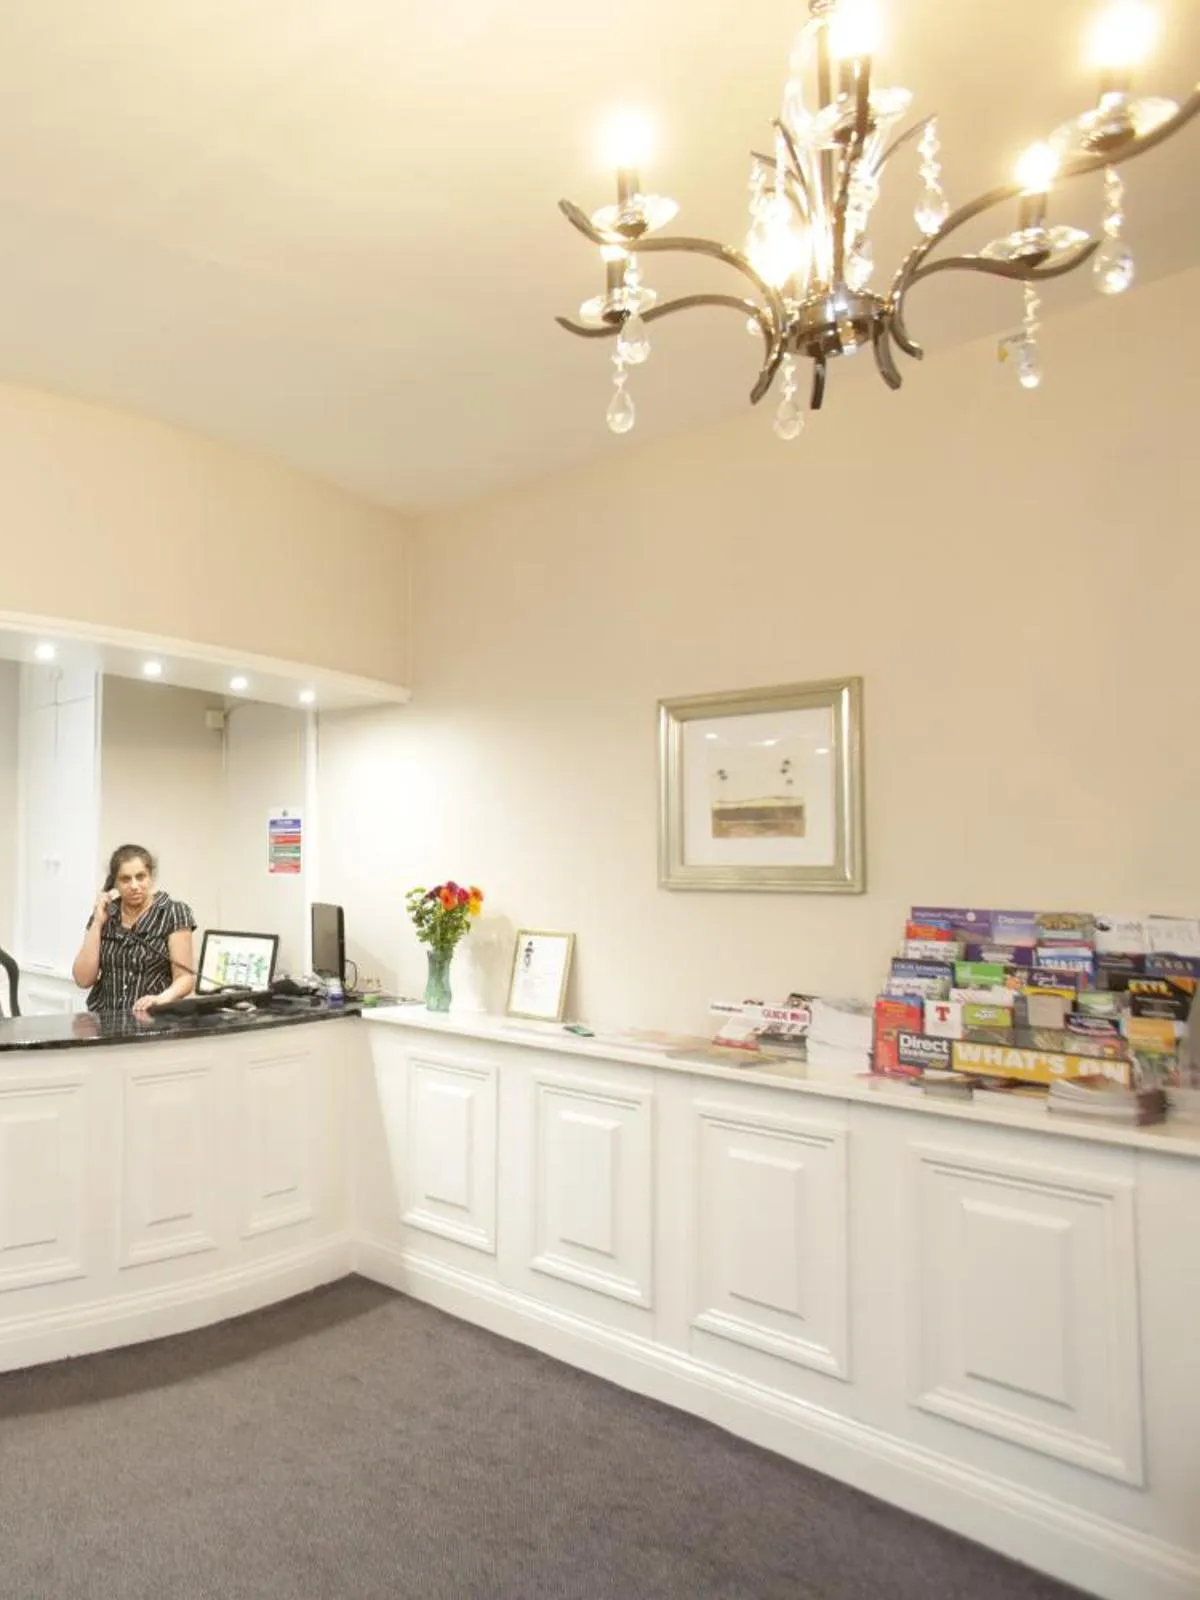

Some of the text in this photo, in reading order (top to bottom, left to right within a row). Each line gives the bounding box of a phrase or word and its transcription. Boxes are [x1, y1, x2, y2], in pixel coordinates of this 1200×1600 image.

[762, 1008, 788, 1021] GUIDE
[900, 1034, 949, 1053] Direct
[957, 1043, 1066, 1074] WHAT'S
